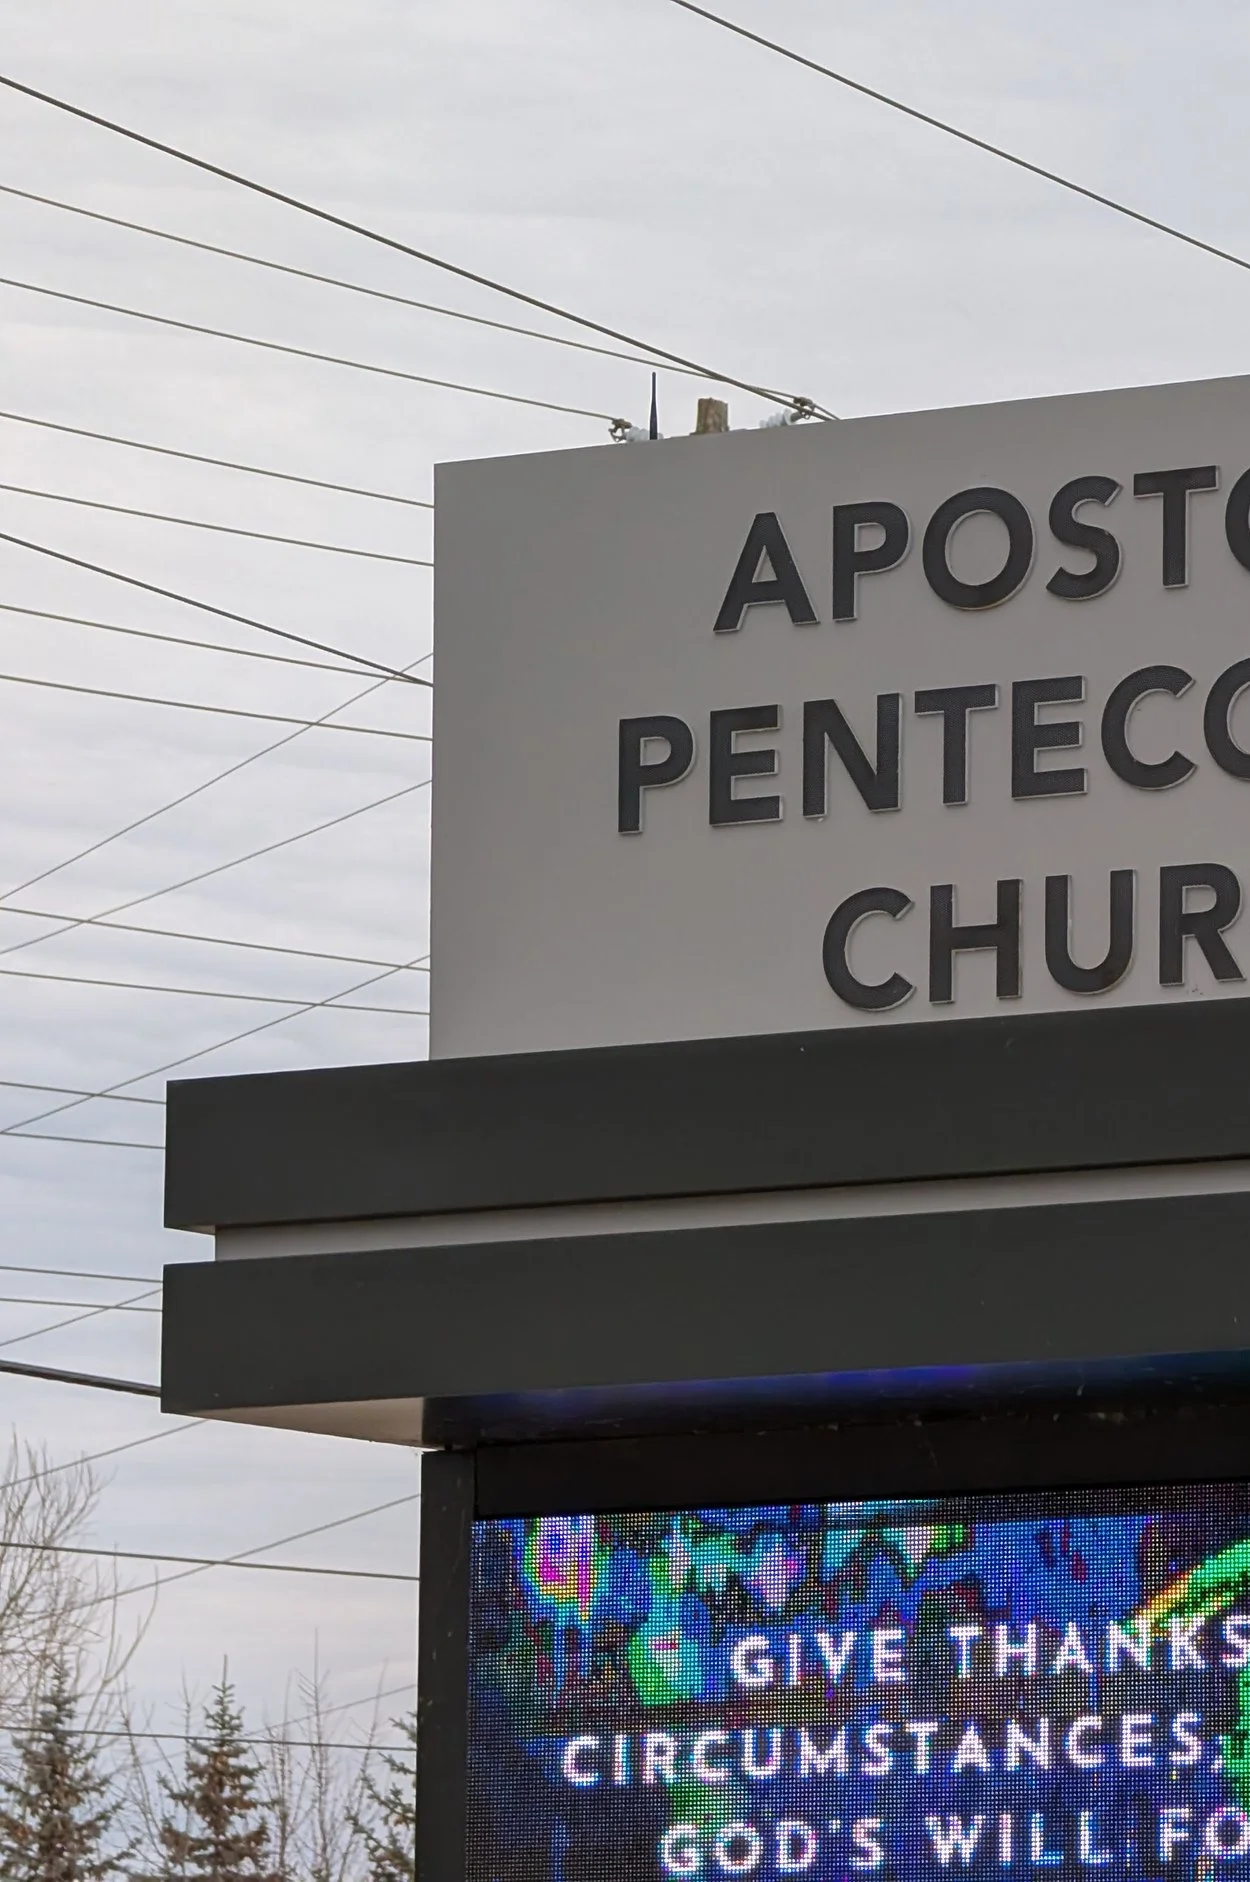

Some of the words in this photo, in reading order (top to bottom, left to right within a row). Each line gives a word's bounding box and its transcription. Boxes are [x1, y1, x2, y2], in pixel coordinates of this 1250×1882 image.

[730, 1628, 907, 1687] GIVE
[660, 1817, 885, 1876] GOD'S
[924, 1810, 1112, 1867] WILL
